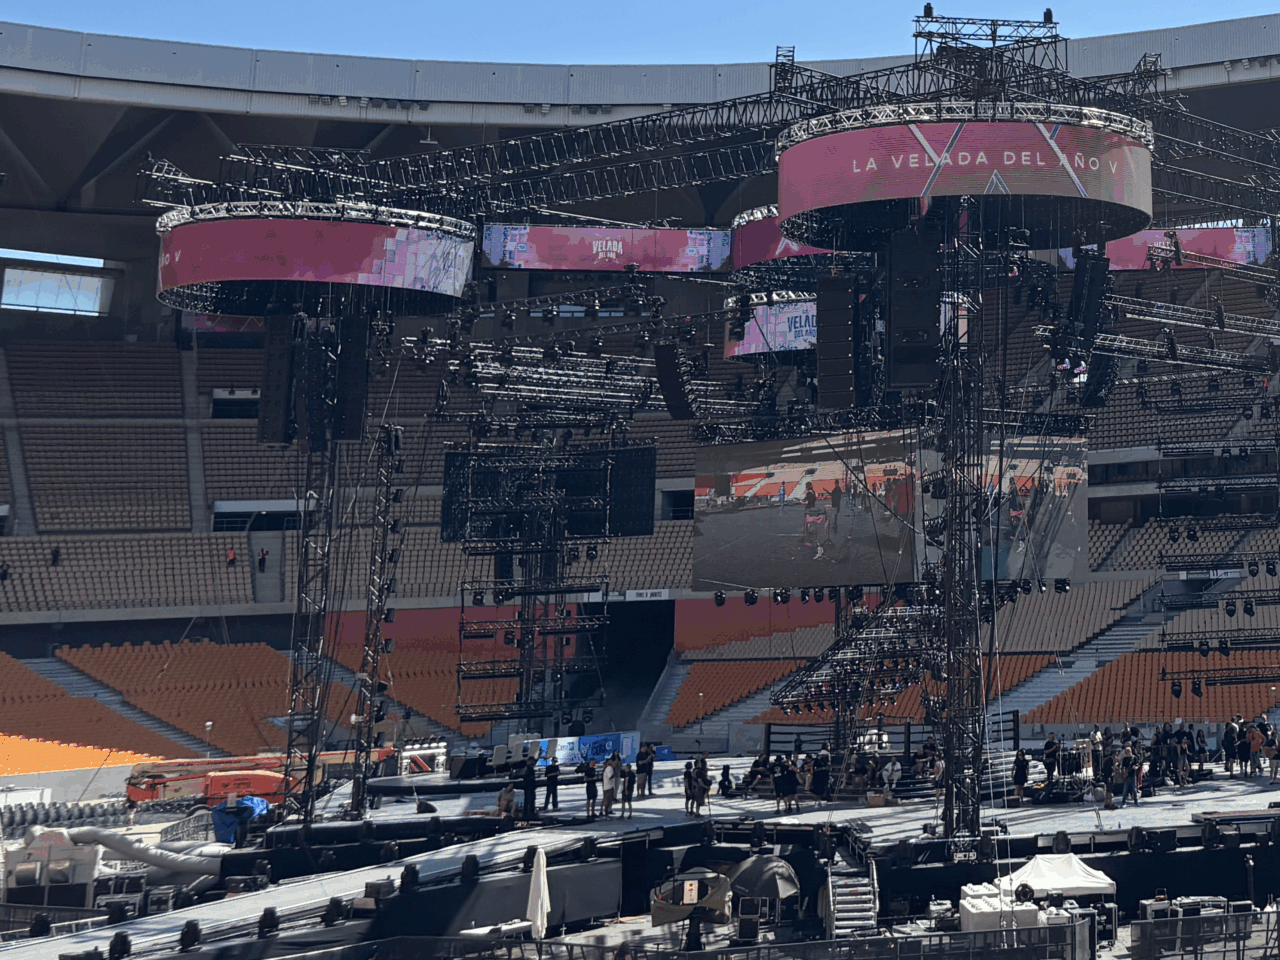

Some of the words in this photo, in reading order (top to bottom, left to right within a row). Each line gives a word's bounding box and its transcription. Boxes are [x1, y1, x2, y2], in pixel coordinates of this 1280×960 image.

[852, 157, 878, 173] LA
[891, 151, 989, 169] VELADA
[1003, 151, 1046, 165] DEL
[1108, 160, 1118, 174] V
[174, 250, 181, 262] V
[592, 240, 623, 255] VELADA
[787, 314, 817, 333] VELAD
